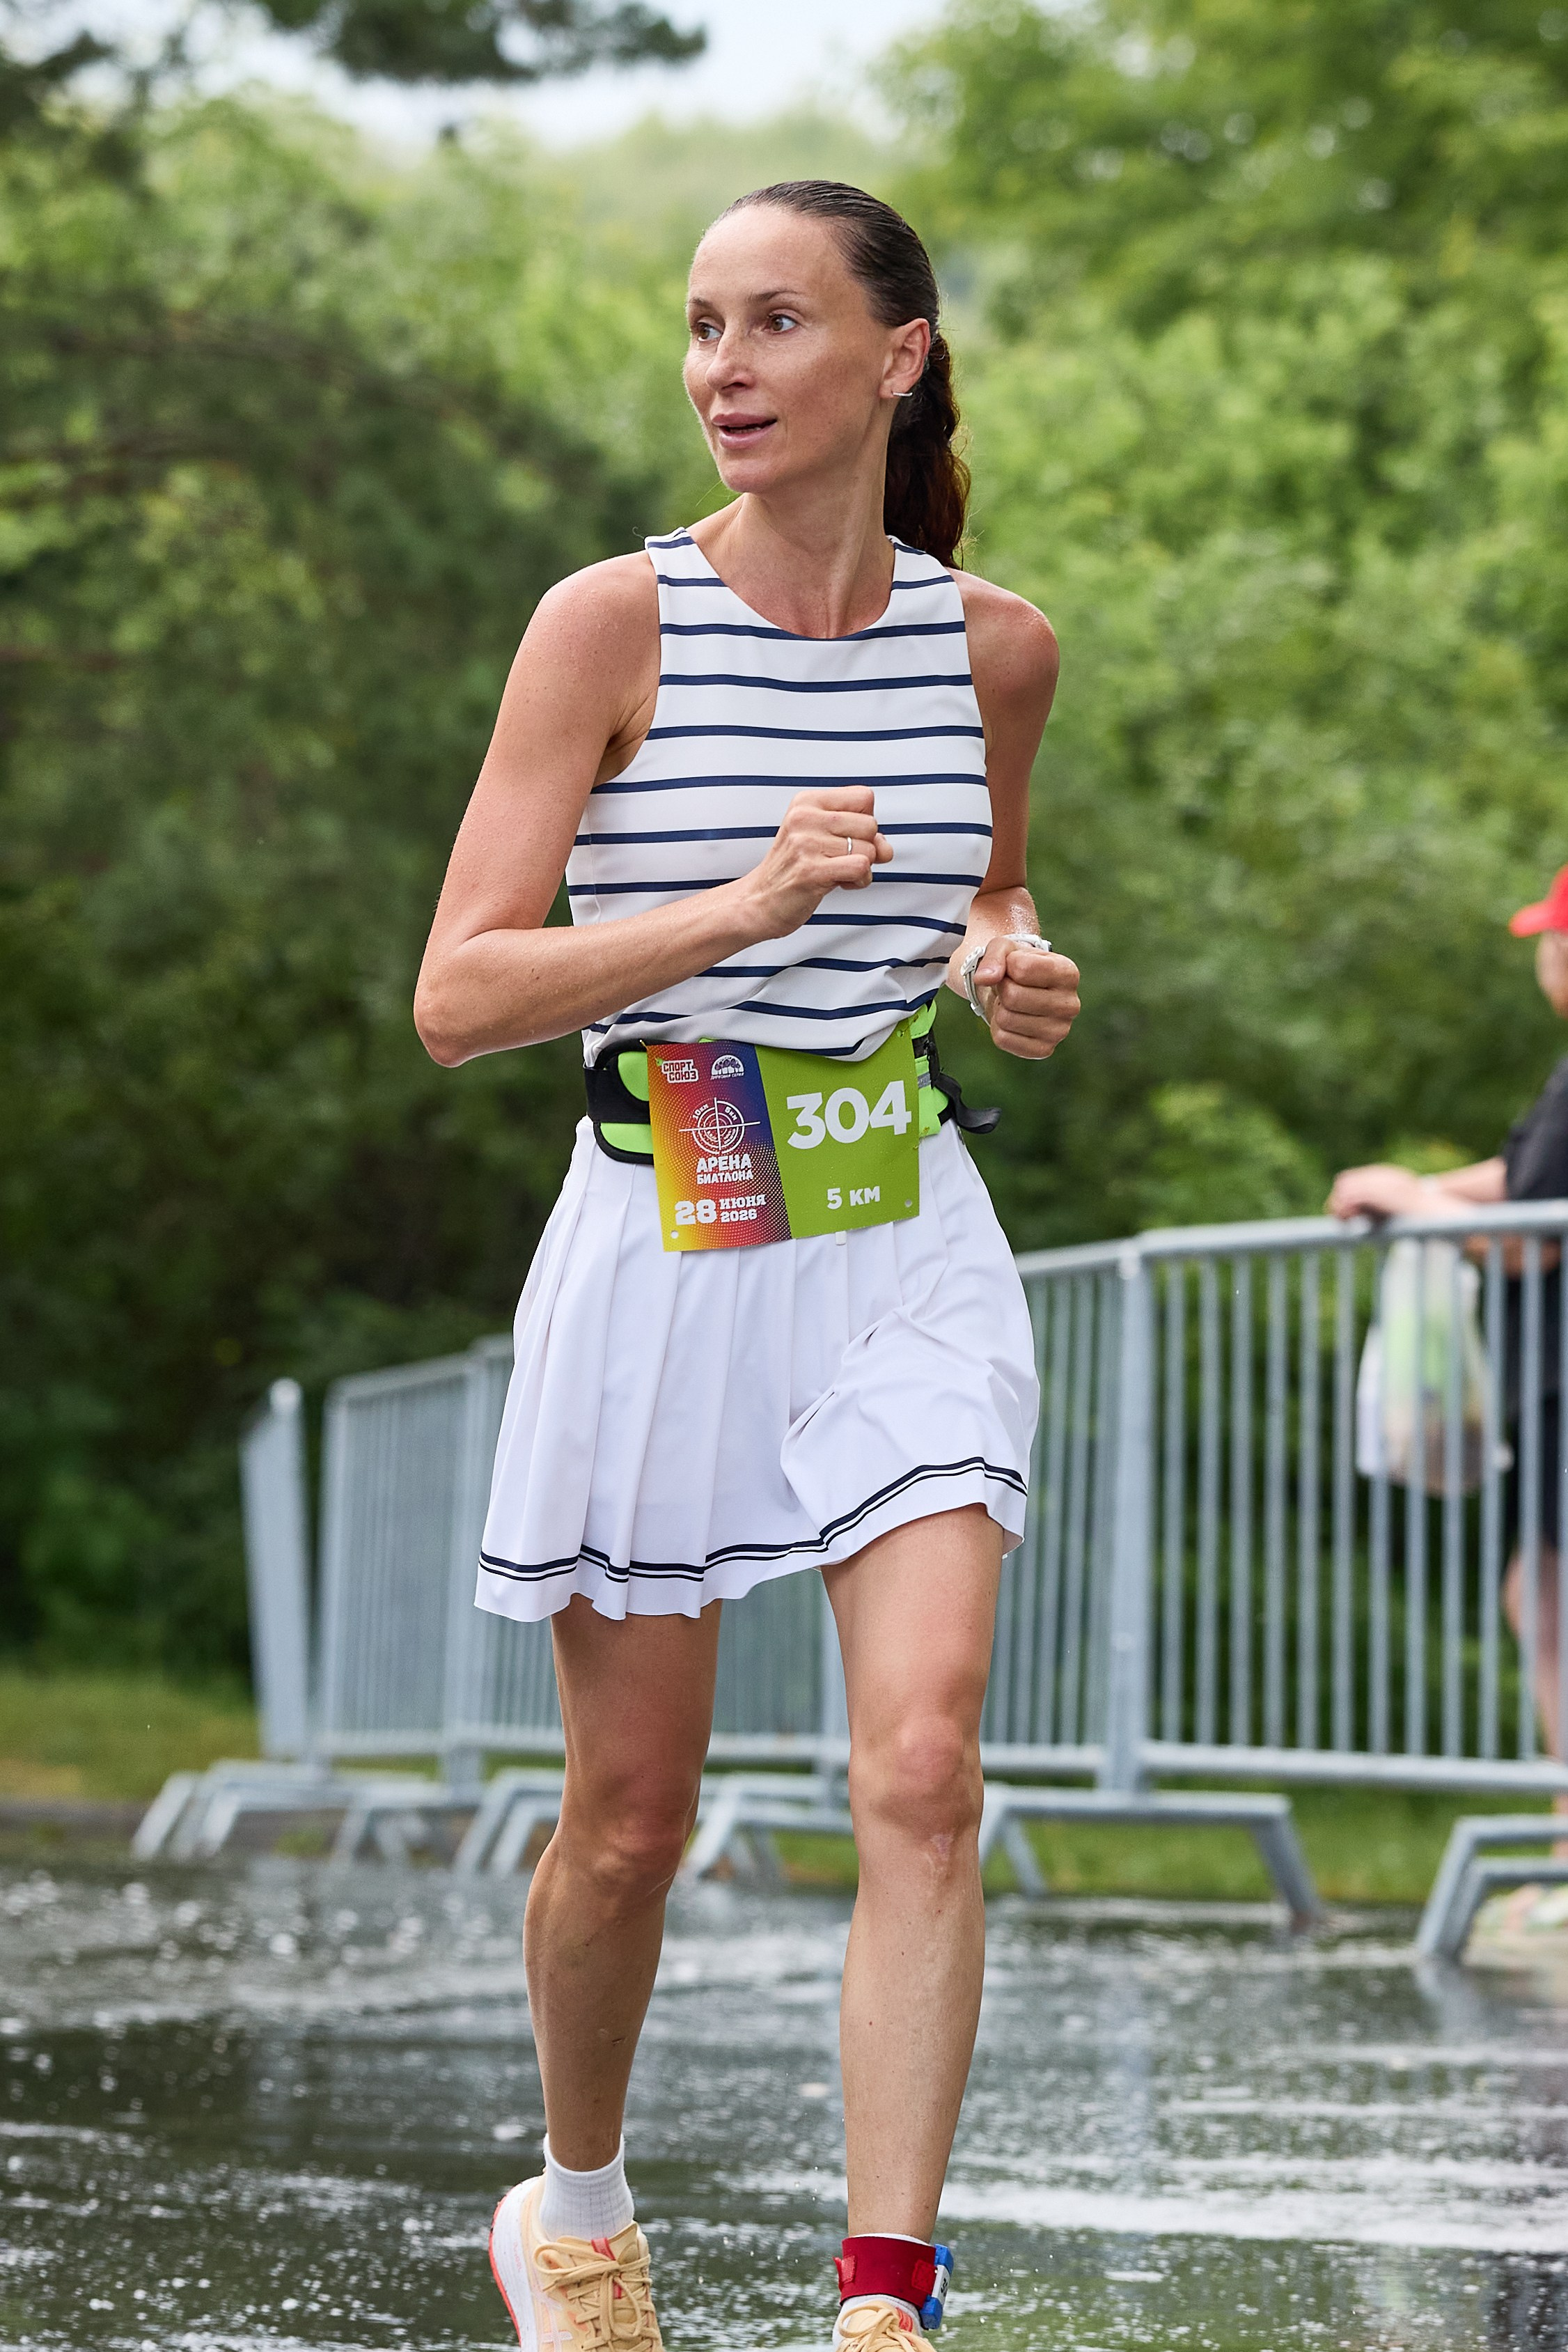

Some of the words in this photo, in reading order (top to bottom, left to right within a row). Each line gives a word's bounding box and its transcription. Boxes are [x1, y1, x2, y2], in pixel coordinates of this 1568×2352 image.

[663, 1061, 692, 1072] СПОРТ
[669, 1071, 697, 1082] СОЮЗ
[786, 1080, 912, 1150] 304
[696, 1153, 752, 1173] АРЕНА
[696, 1170, 754, 1185] БИАТЛОНА
[826, 1187, 842, 1210] 5
[674, 1199, 718, 1226] 28
[721, 1208, 758, 1223] 2026
